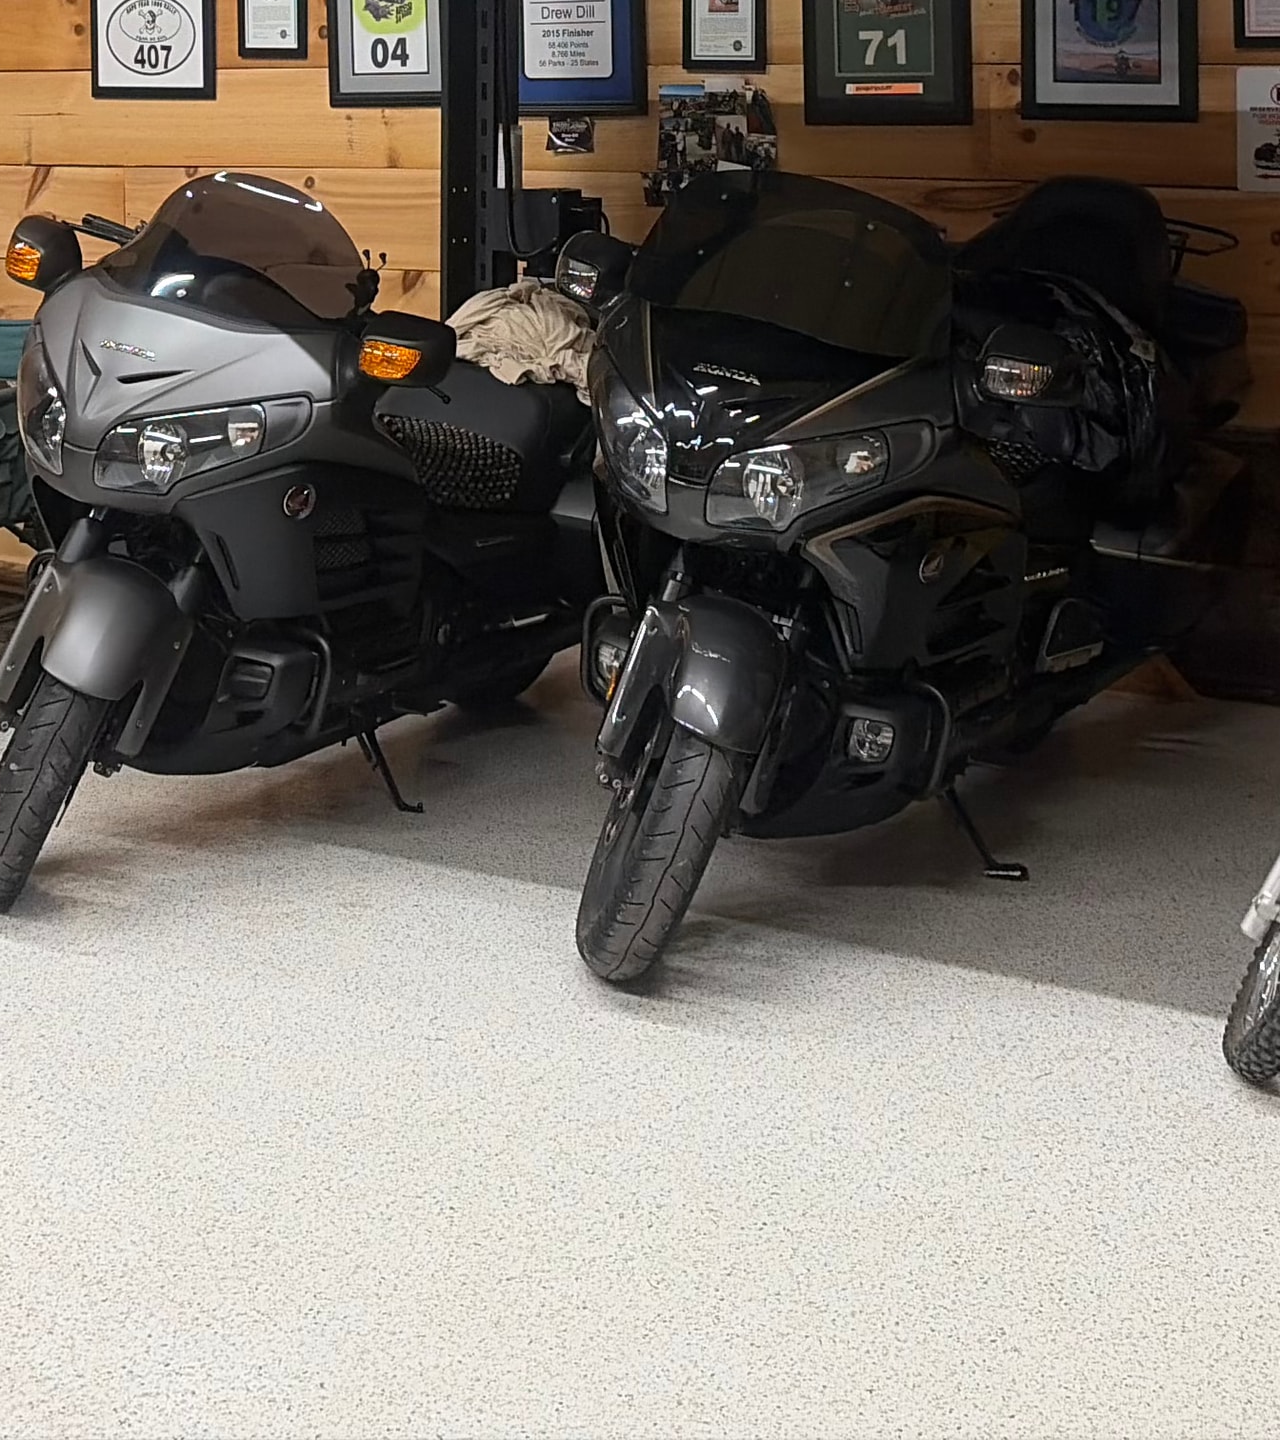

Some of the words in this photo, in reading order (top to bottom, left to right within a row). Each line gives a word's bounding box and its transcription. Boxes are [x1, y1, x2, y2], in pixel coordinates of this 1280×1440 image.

[540, 7, 572, 20] Drew
[576, 5, 595, 19] Dill
[542, 30, 560, 38] 2015
[562, 28, 594, 38] Finisher
[370, 37, 410, 69] 04
[570, 50, 586, 58] Miles
[858, 28, 907, 65] 71
[134, 44, 173, 70] 407
